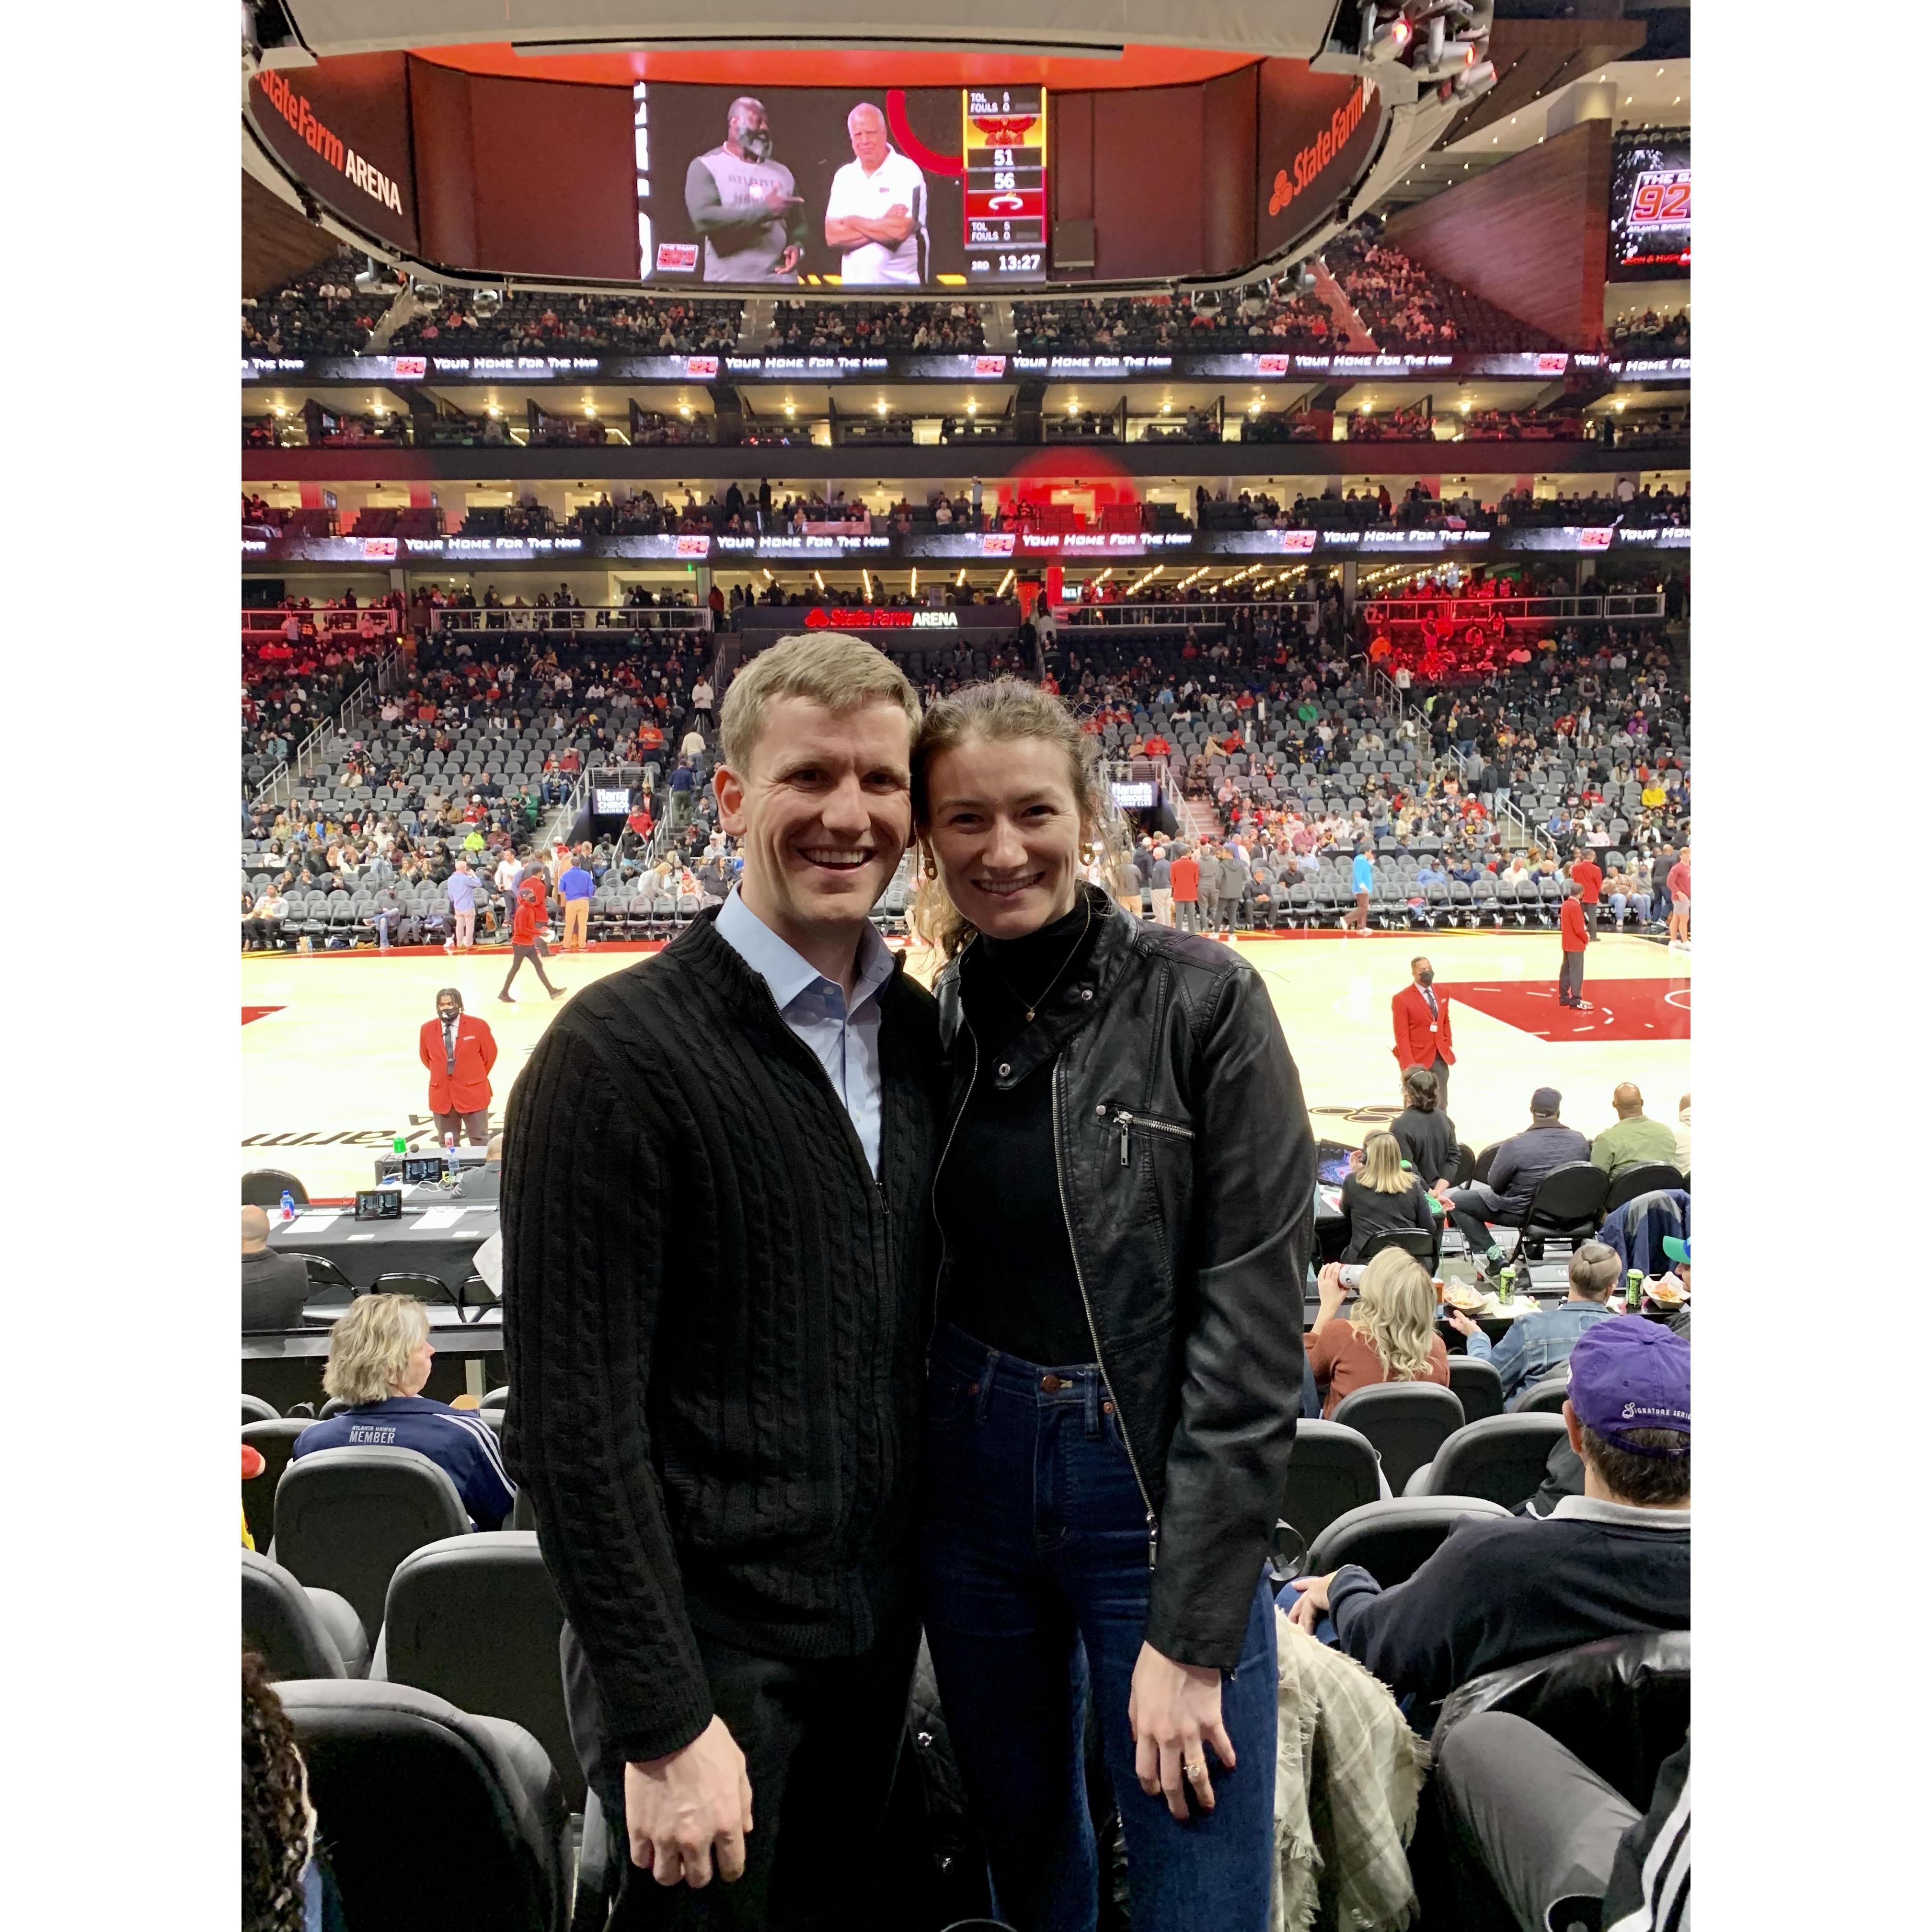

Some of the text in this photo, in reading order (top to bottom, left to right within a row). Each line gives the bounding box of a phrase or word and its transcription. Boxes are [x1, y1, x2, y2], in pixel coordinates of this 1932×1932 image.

[971, 92, 986, 102] TOL
[970, 103, 998, 113] FOULS
[994, 150, 1013, 166] 51
[345, 149, 402, 216] ARENA
[994, 173, 1015, 189] 56
[1642, 173, 1674, 184] THE
[971, 222, 987, 231] TOL
[971, 231, 999, 241] FOULS
[971, 255, 1040, 271] 3RD 13:27
[912, 611, 958, 627] ARENA
[1622, 1402, 1670, 1419] SIGNATURE
[349, 1431, 395, 1444] MEMBER
